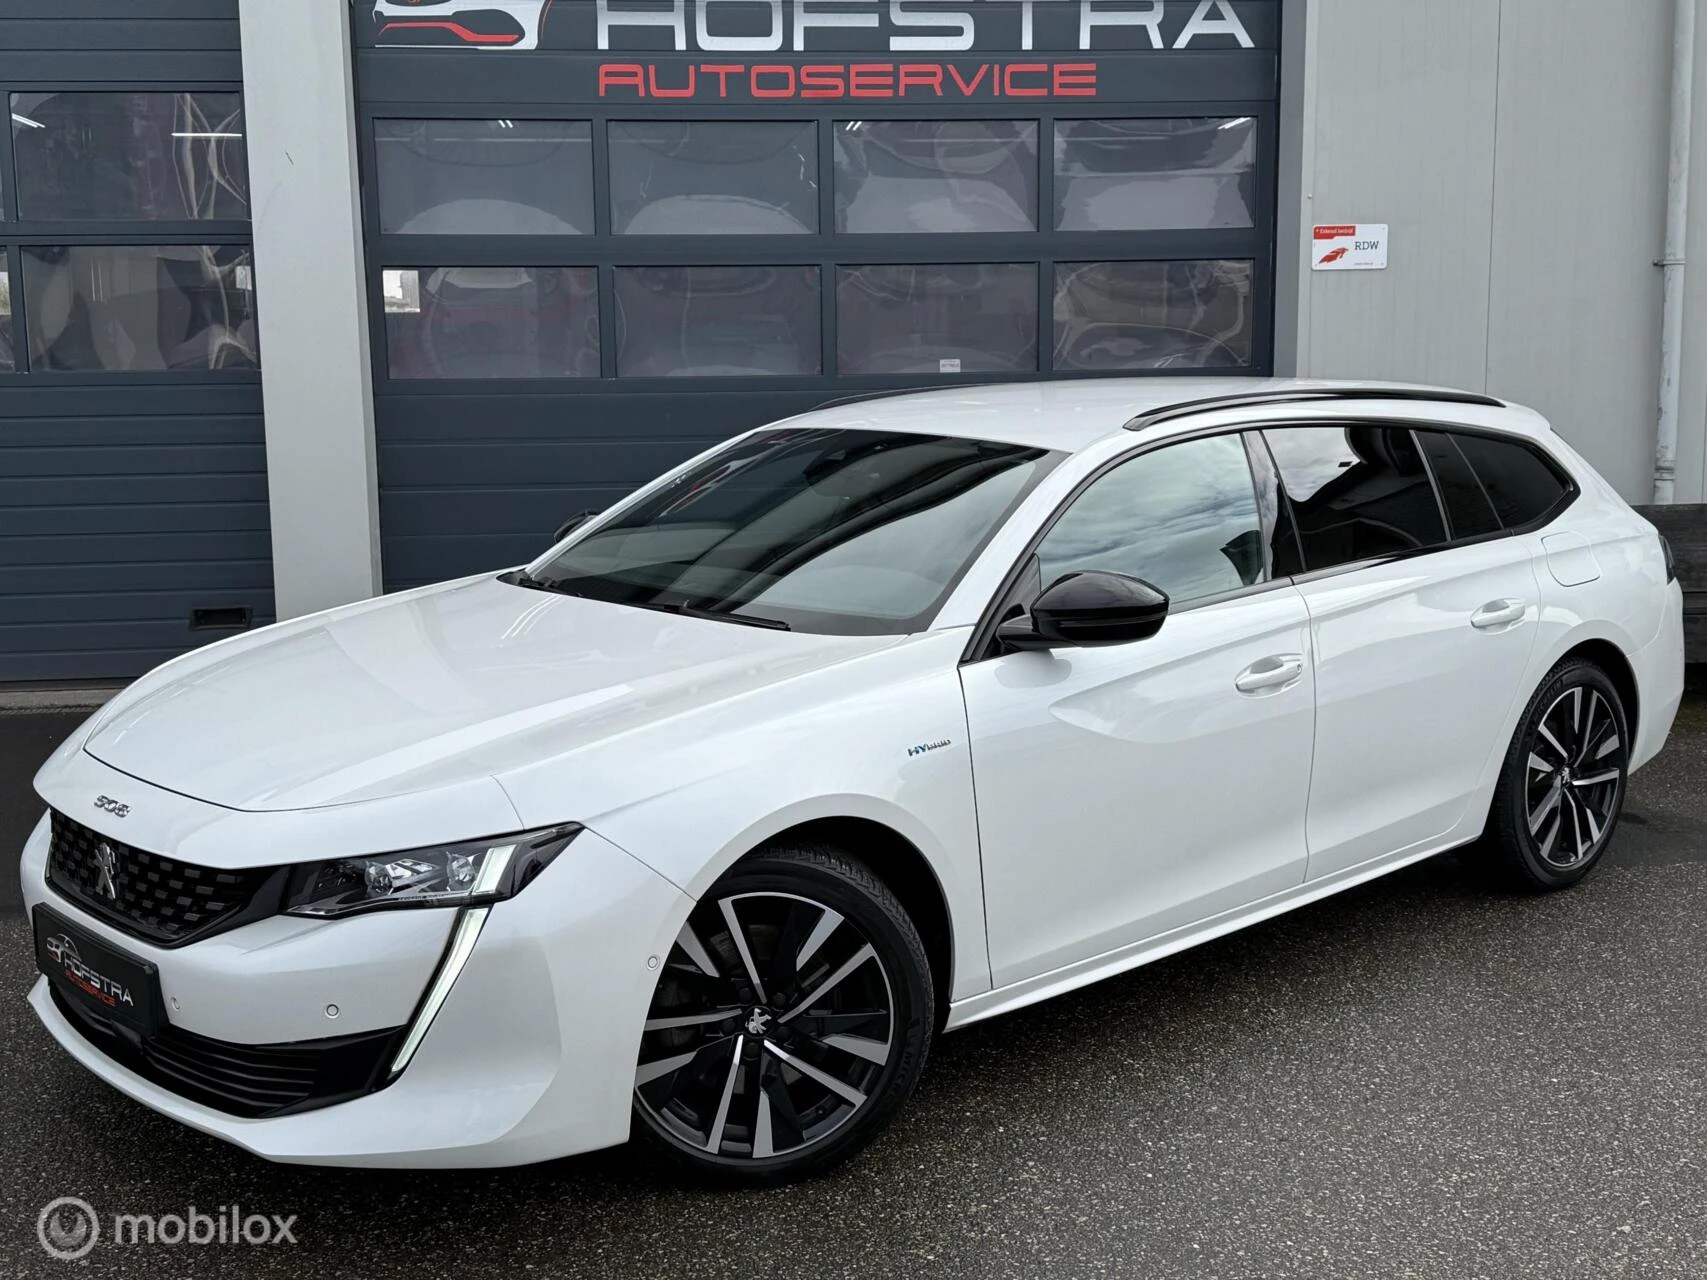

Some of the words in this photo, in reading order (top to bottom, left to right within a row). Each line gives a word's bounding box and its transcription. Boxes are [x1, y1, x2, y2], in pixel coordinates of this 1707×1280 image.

[597, 0, 1254, 51] HOFSTRA
[599, 64, 1097, 98] AUTOSERVICE
[1354, 240, 1380, 251] RDW
[94, 795, 131, 818] 508
[64, 950, 134, 1007] HOFSTRA
